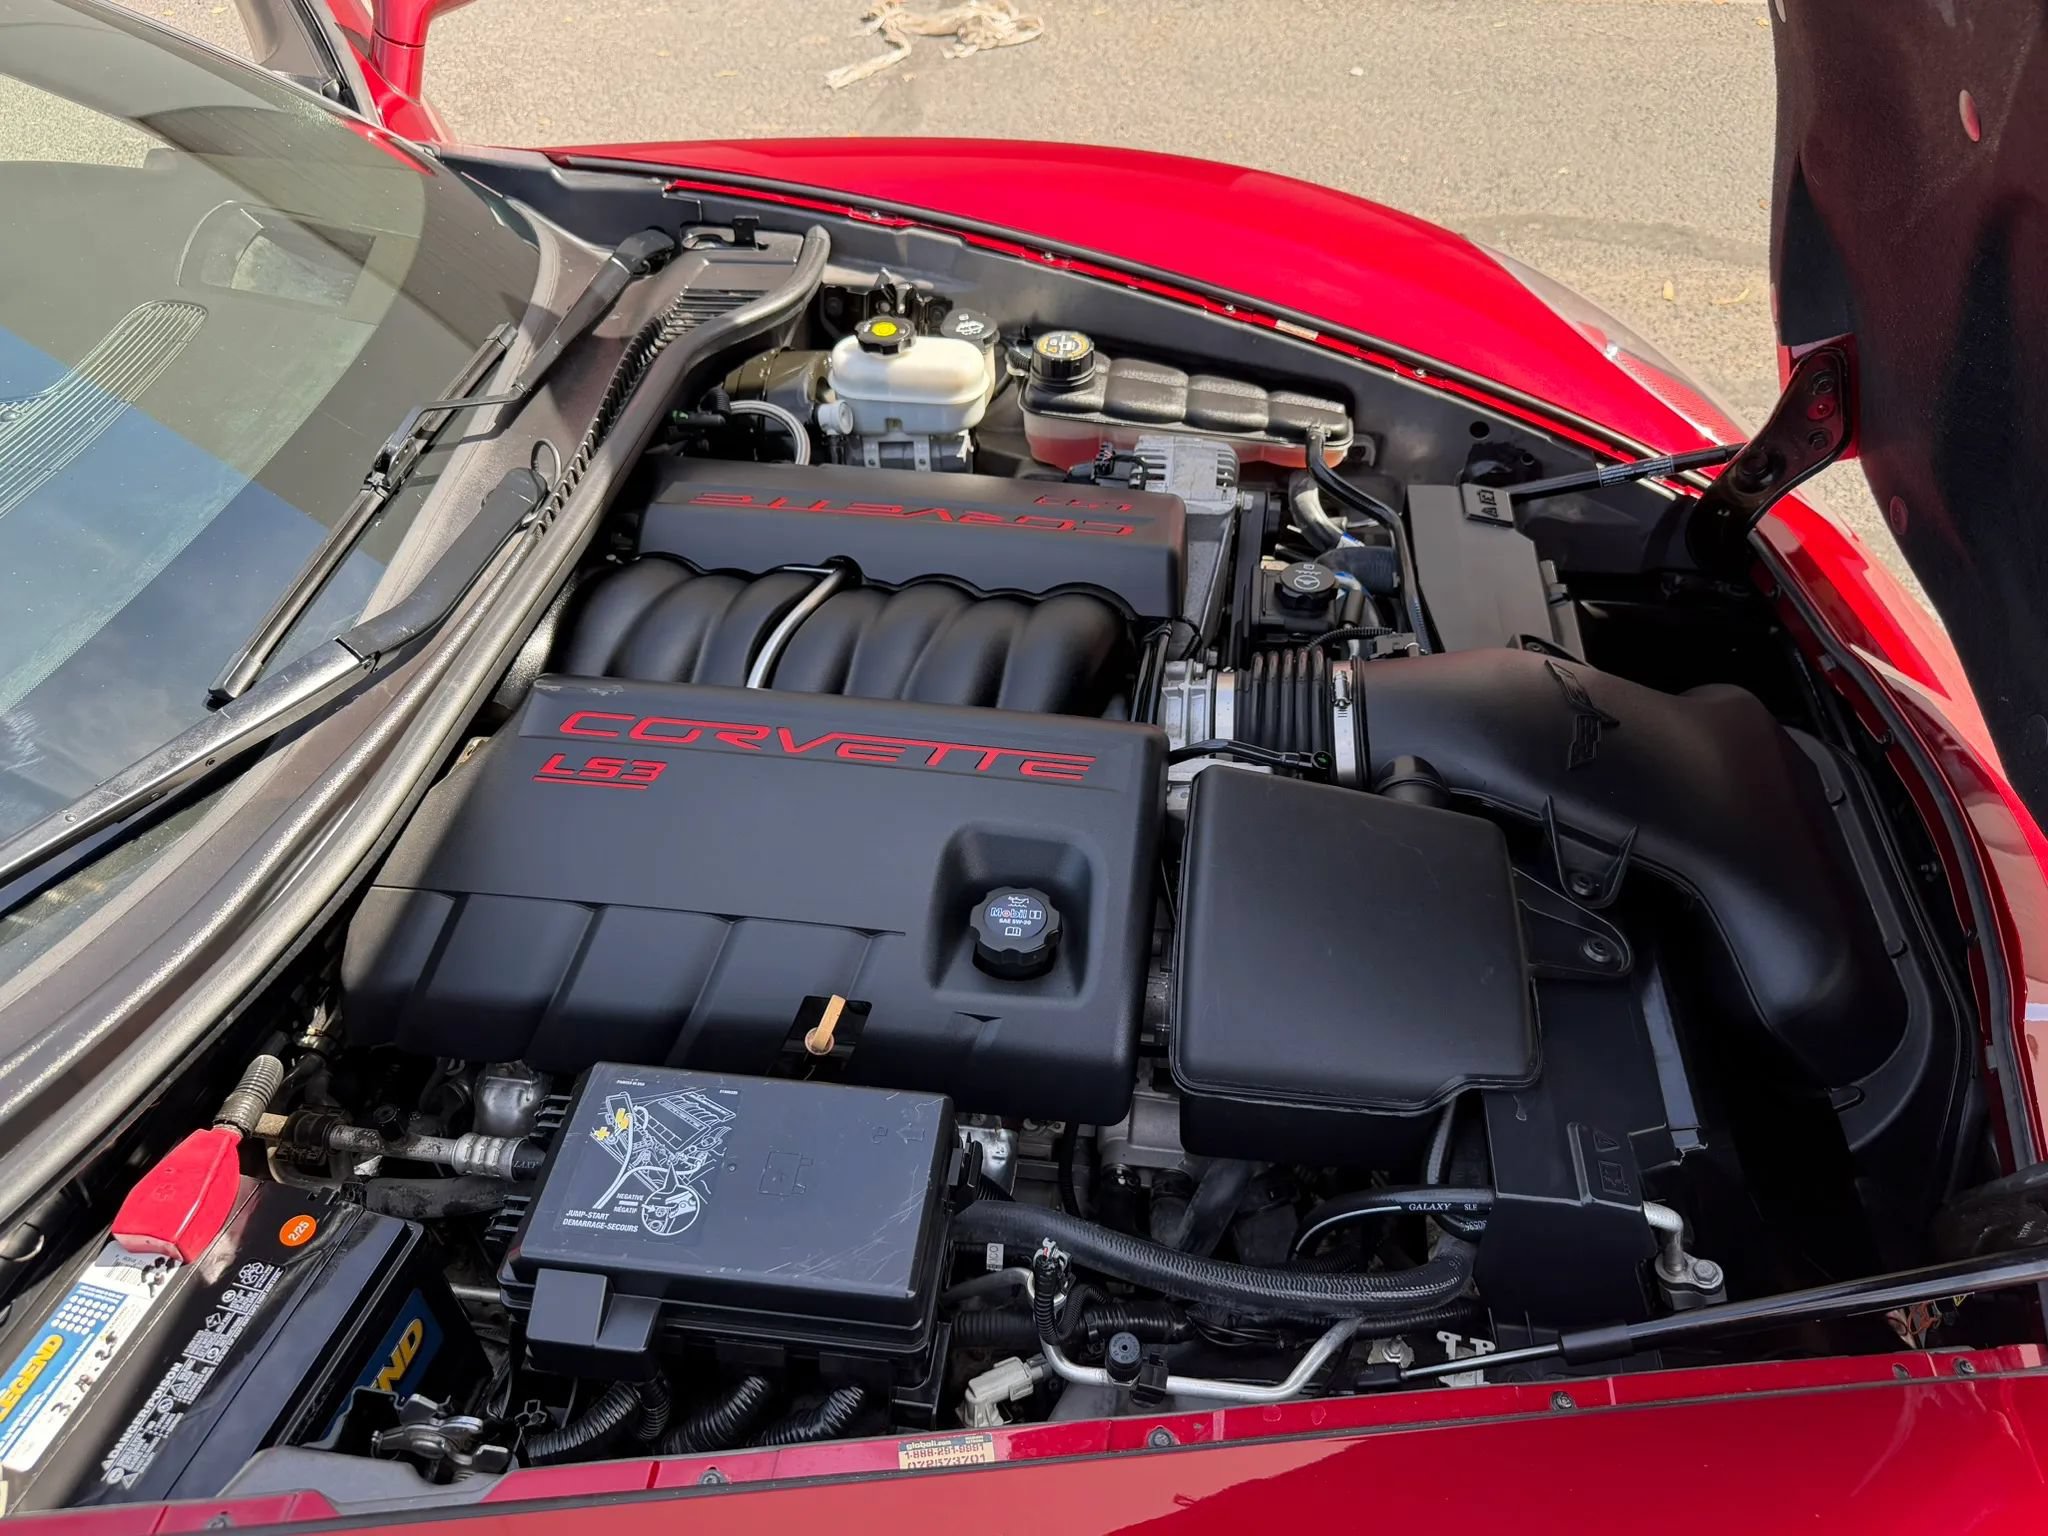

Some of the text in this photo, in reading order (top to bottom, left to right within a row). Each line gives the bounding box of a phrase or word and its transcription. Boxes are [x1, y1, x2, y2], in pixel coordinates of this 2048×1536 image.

[689, 493, 1135, 536] CORVETTE
[559, 710, 1097, 780] CORVETTE
[539, 752, 668, 783] LS3
[990, 907, 1027, 919] Mobil
[616, 1192, 645, 1201] NEGATIVE
[566, 1209, 610, 1220] JUMP-START
[1408, 1203, 1452, 1212] GALAXY
[287, 1220, 310, 1242] 2/25
[562, 1218, 639, 1233] DEMARRAGE-SECOURS
[107, 1362, 184, 1465] DANGER/POISON
